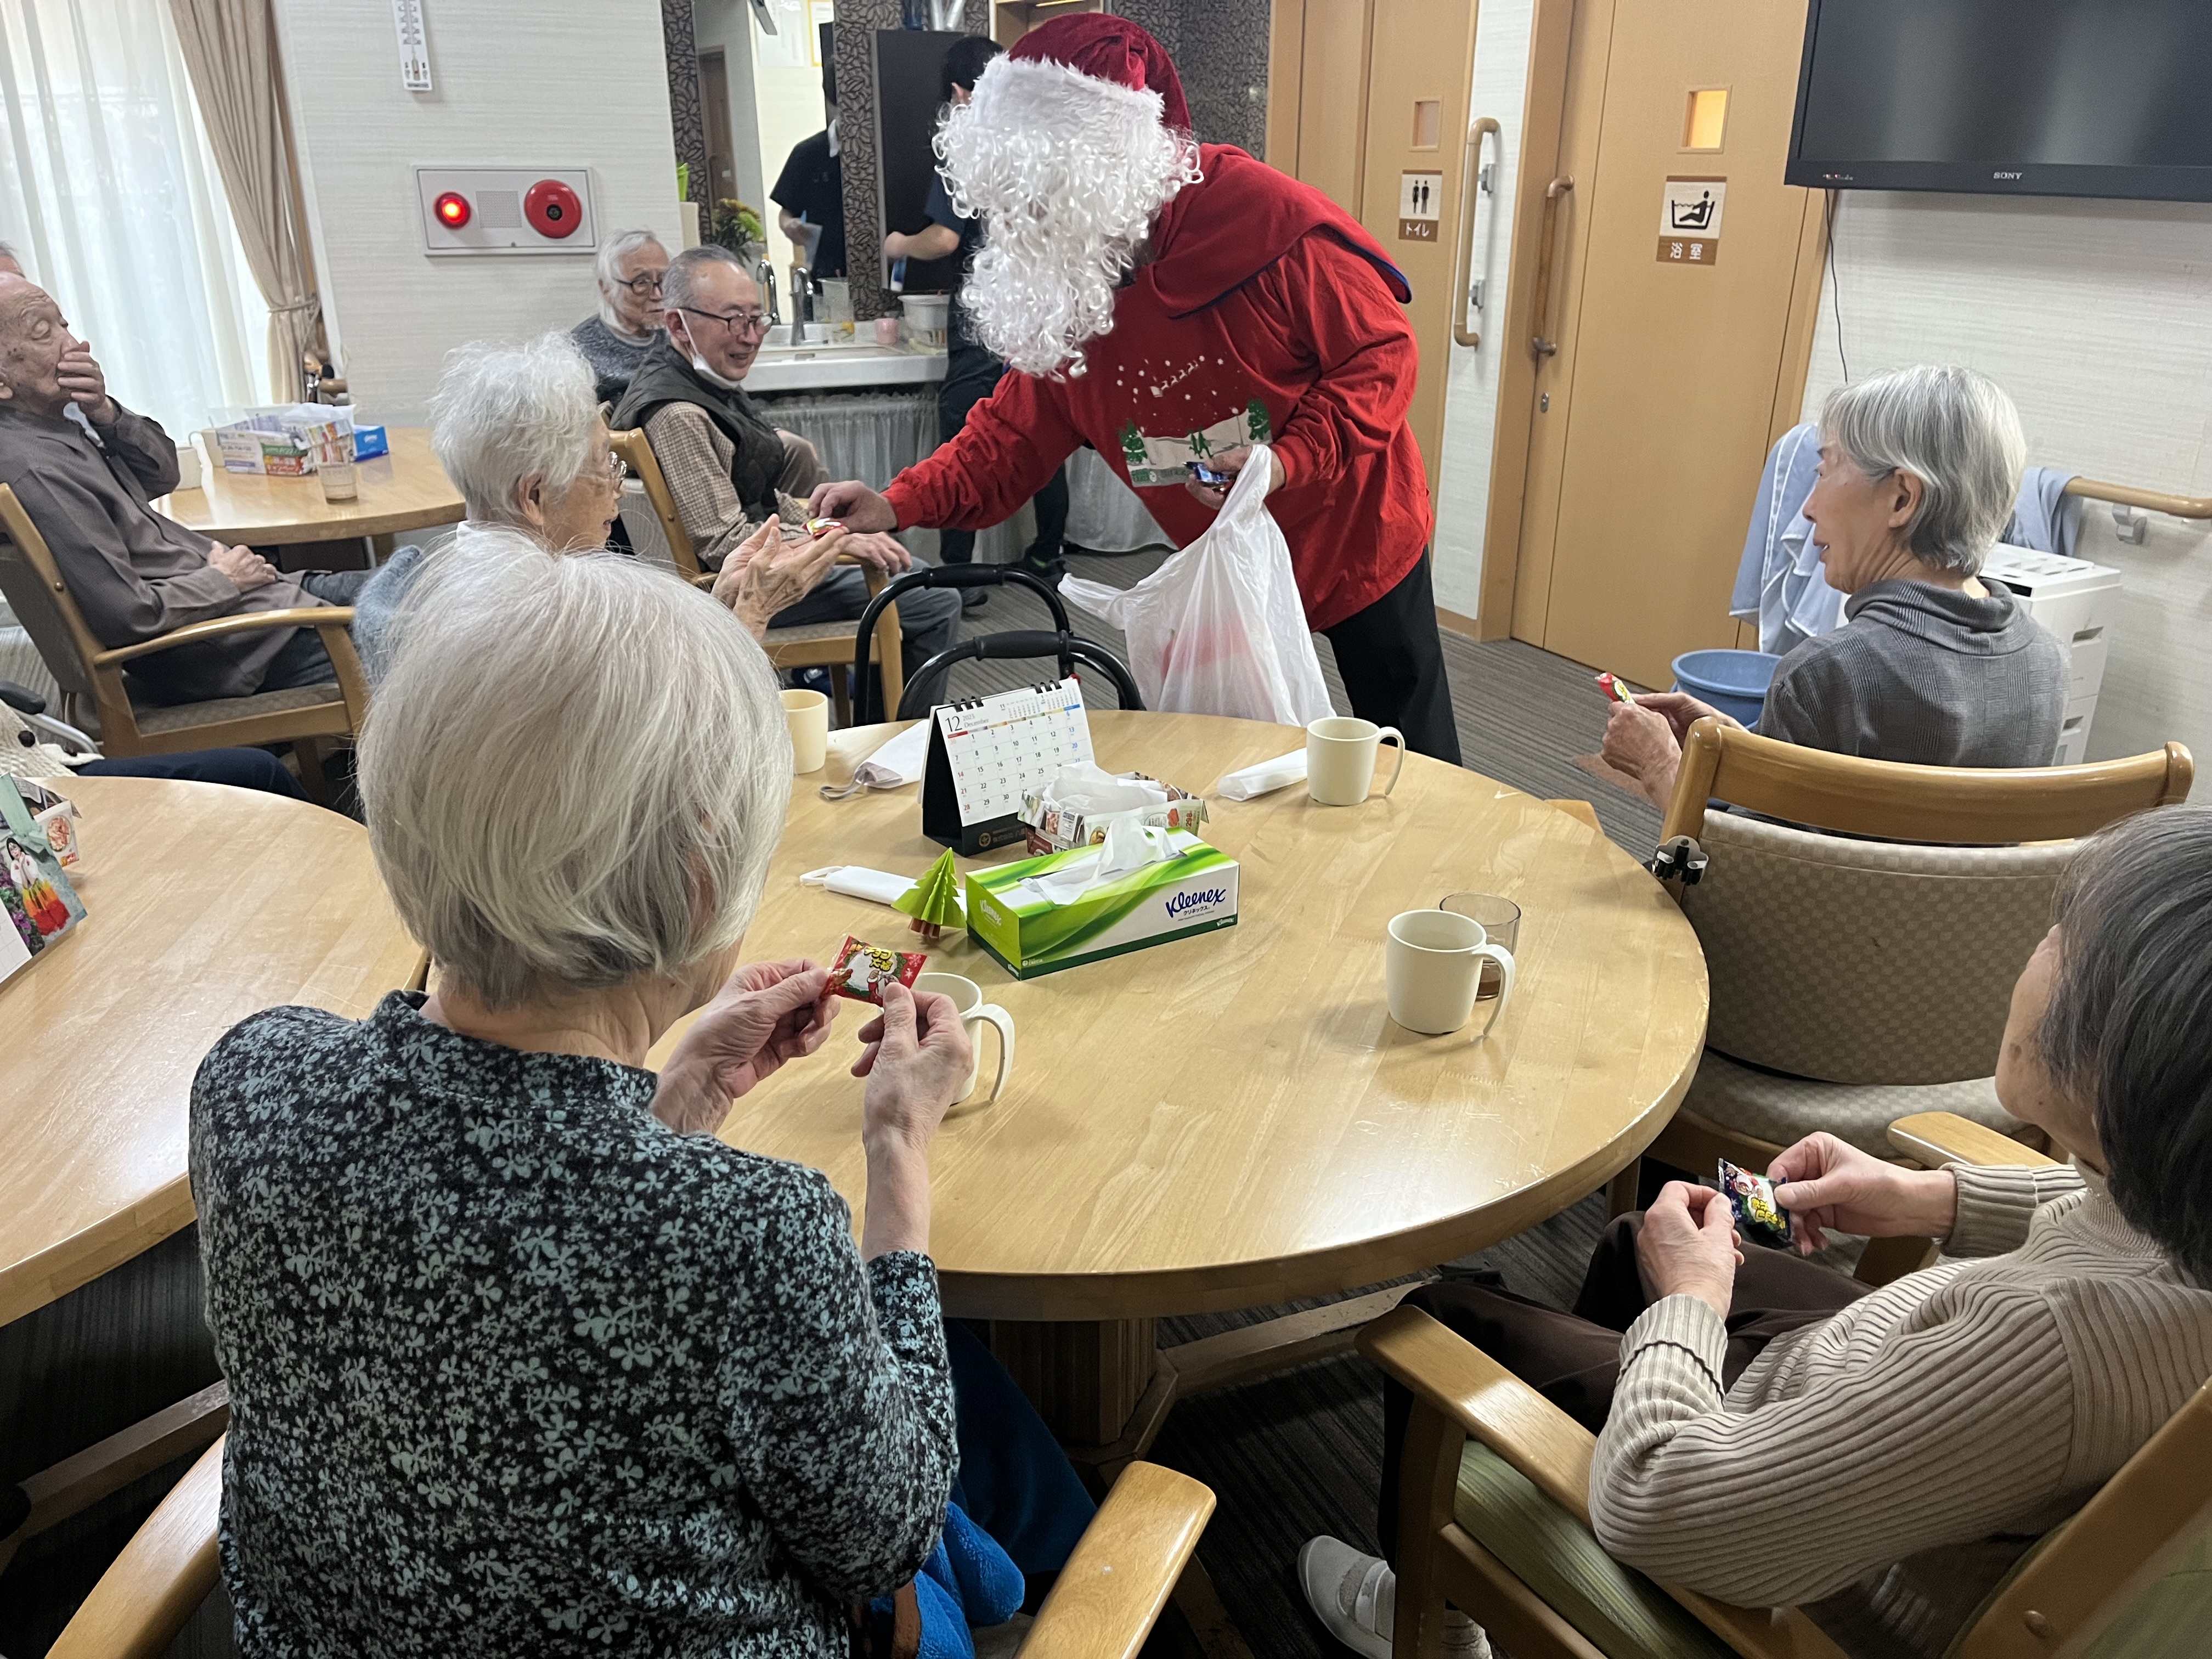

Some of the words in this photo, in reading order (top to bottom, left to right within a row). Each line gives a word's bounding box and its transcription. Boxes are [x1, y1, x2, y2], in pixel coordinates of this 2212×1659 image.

[1993, 171, 2023, 179] SONY
[1406, 222, 1430, 237] トイレ
[1670, 242, 1703, 260] 浴室
[945, 715, 963, 732] 12
[964, 718, 989, 728] December
[1165, 888, 1226, 918] Kleenex
[1183, 905, 1208, 916] クリネックス
[864, 946, 893, 961] チョコ
[869, 958, 893, 972] 大福
